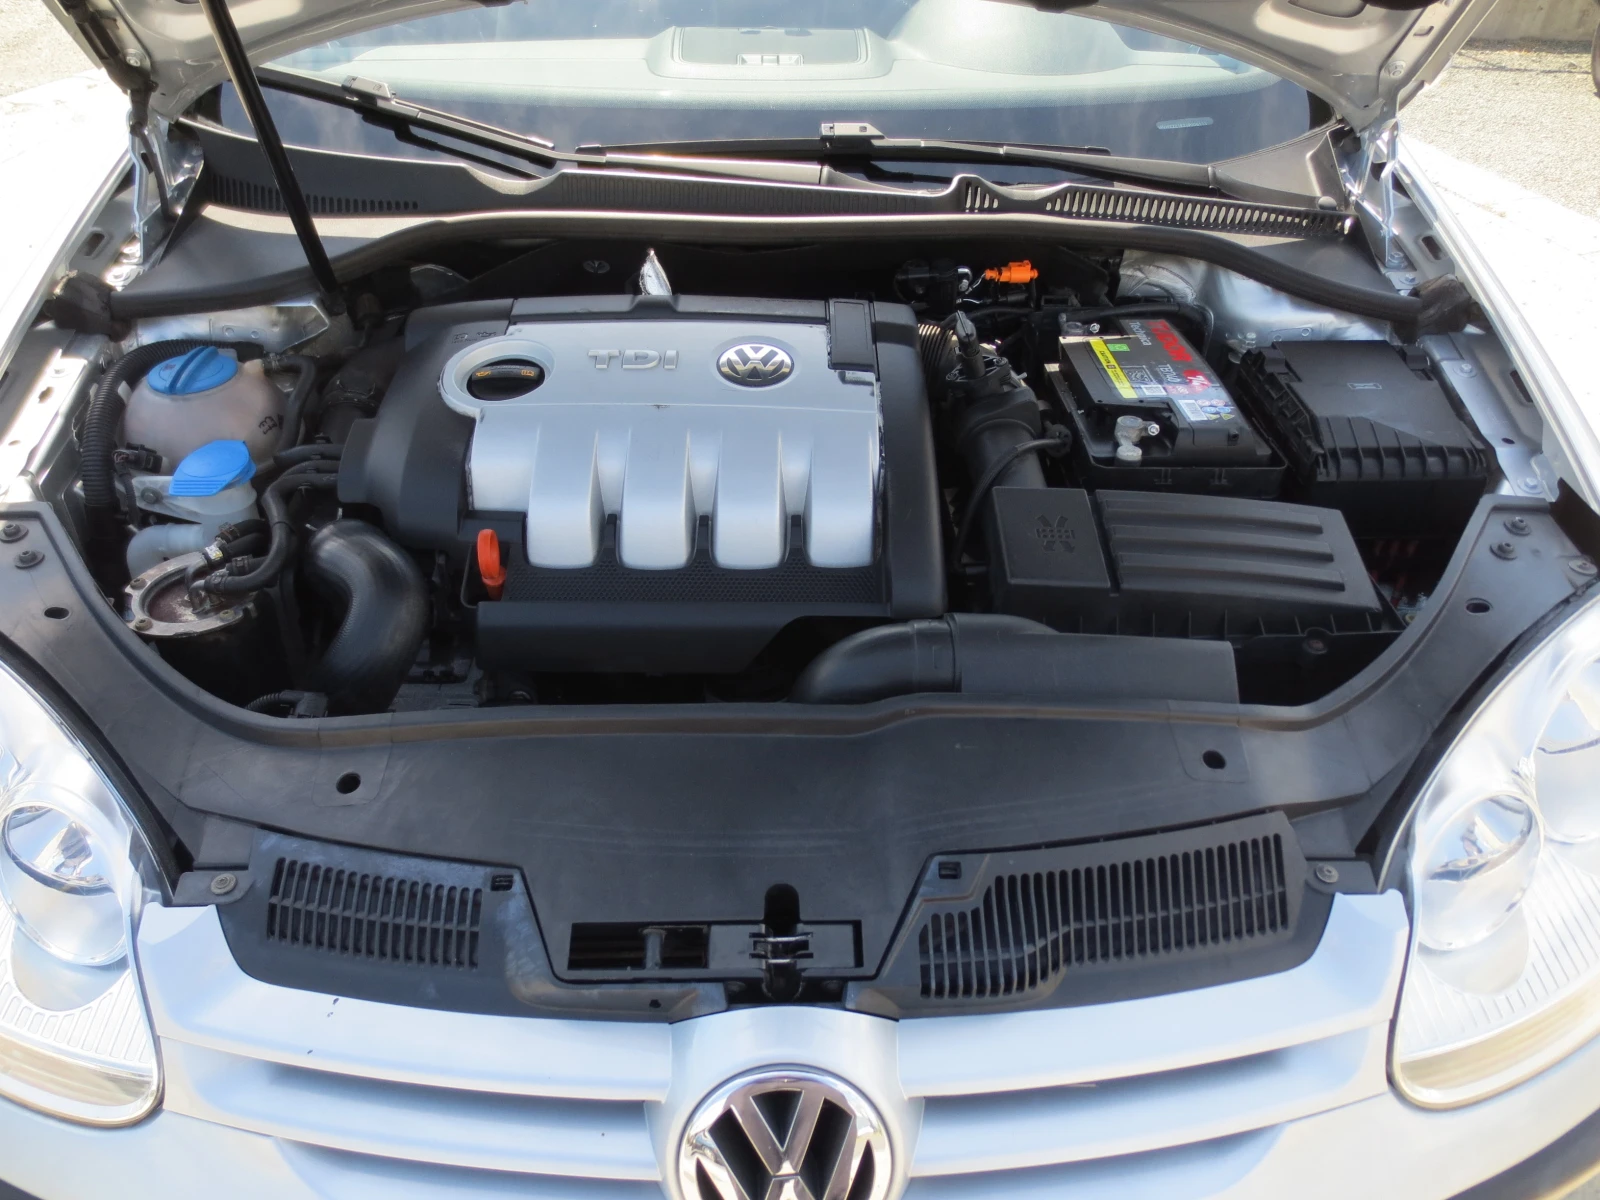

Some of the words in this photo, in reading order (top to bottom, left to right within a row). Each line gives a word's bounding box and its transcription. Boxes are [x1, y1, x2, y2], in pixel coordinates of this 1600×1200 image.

[1129, 322, 1152, 345] Technica
[588, 349, 679, 369] TDI
[717, 343, 795, 388] VW
